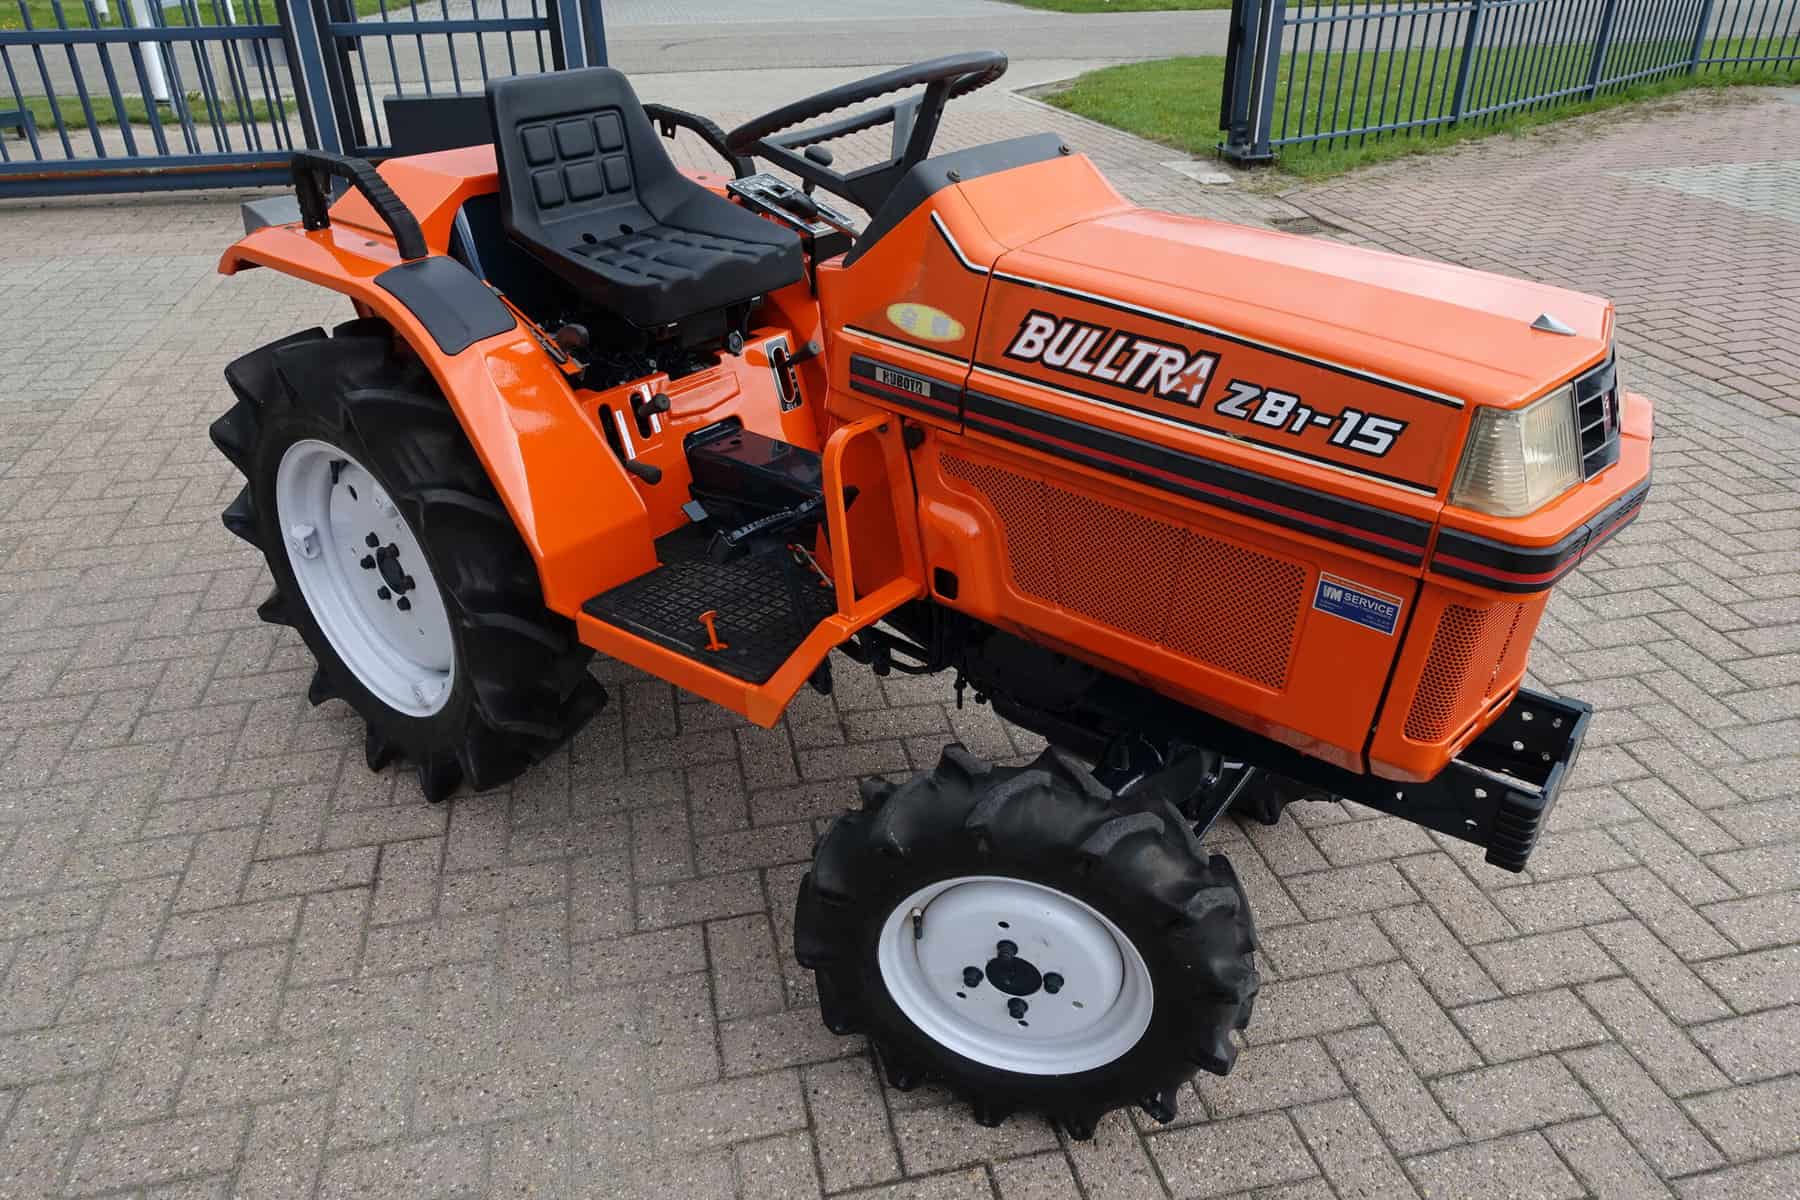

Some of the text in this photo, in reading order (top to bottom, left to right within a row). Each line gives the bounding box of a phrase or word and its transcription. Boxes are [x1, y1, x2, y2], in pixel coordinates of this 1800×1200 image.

[881, 370, 924, 394] KUBOTA
[1008, 312, 1218, 405] BULLTRA
[1215, 381, 1405, 456] ZB1-15
[1343, 592, 1395, 617] SERVICE
